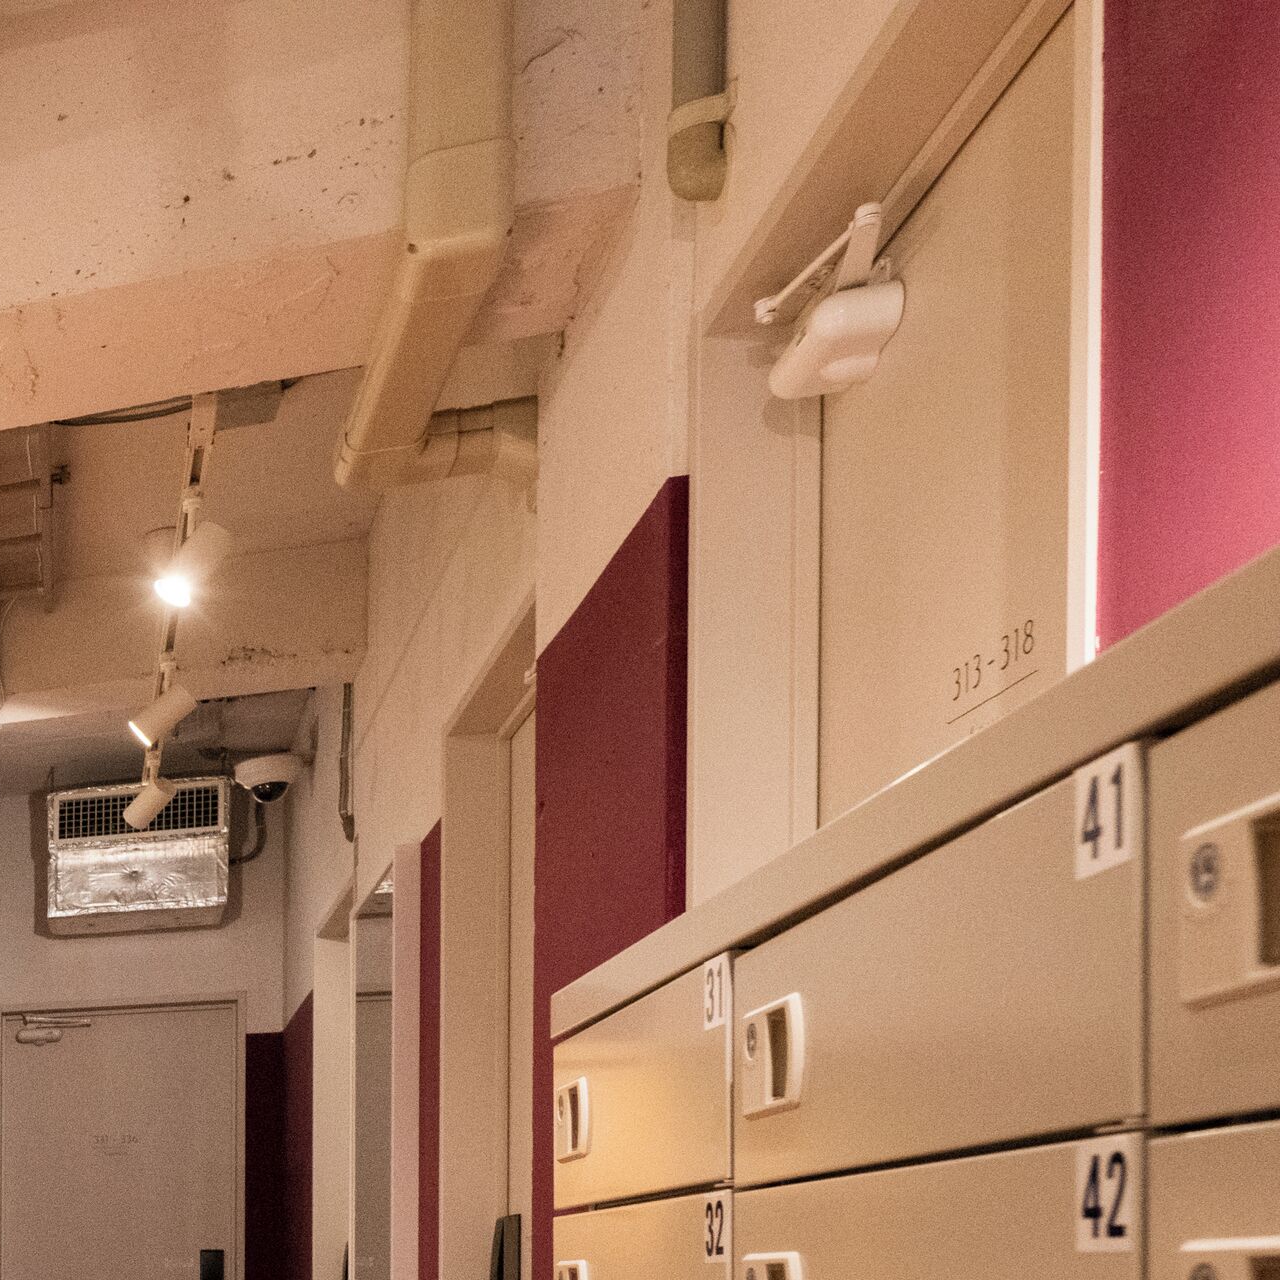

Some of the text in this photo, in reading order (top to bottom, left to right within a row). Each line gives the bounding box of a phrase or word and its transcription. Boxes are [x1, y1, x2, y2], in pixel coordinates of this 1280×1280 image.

[952, 619, 1035, 702] 313-318
[1082, 762, 1123, 859] 41
[706, 962, 722, 1023] 31
[705, 1200, 724, 1256] 32
[1082, 1150, 1127, 1238] 42
